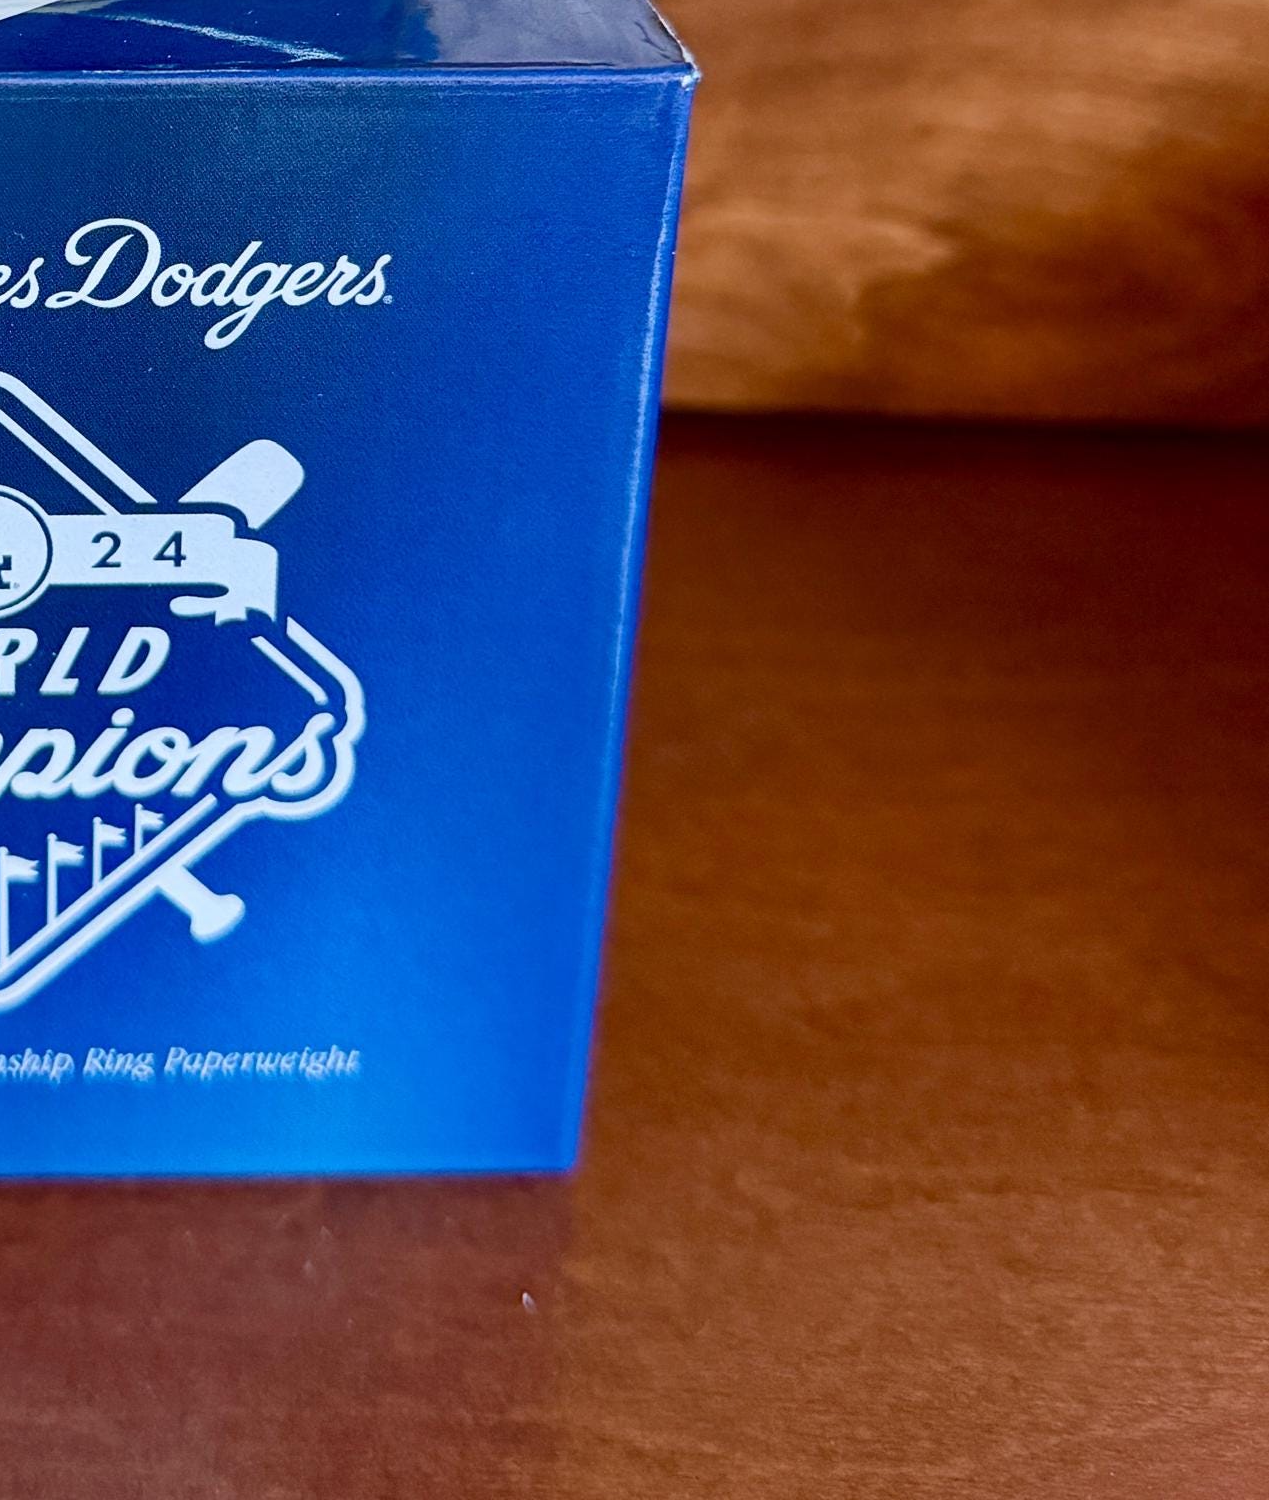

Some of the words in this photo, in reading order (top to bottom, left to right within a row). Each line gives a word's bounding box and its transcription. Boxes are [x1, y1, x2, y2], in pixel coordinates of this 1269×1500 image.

[90, 530, 187, 569] 24
[83, 1047, 155, 1083] Ring
[164, 1045, 360, 1083] Paperweight
